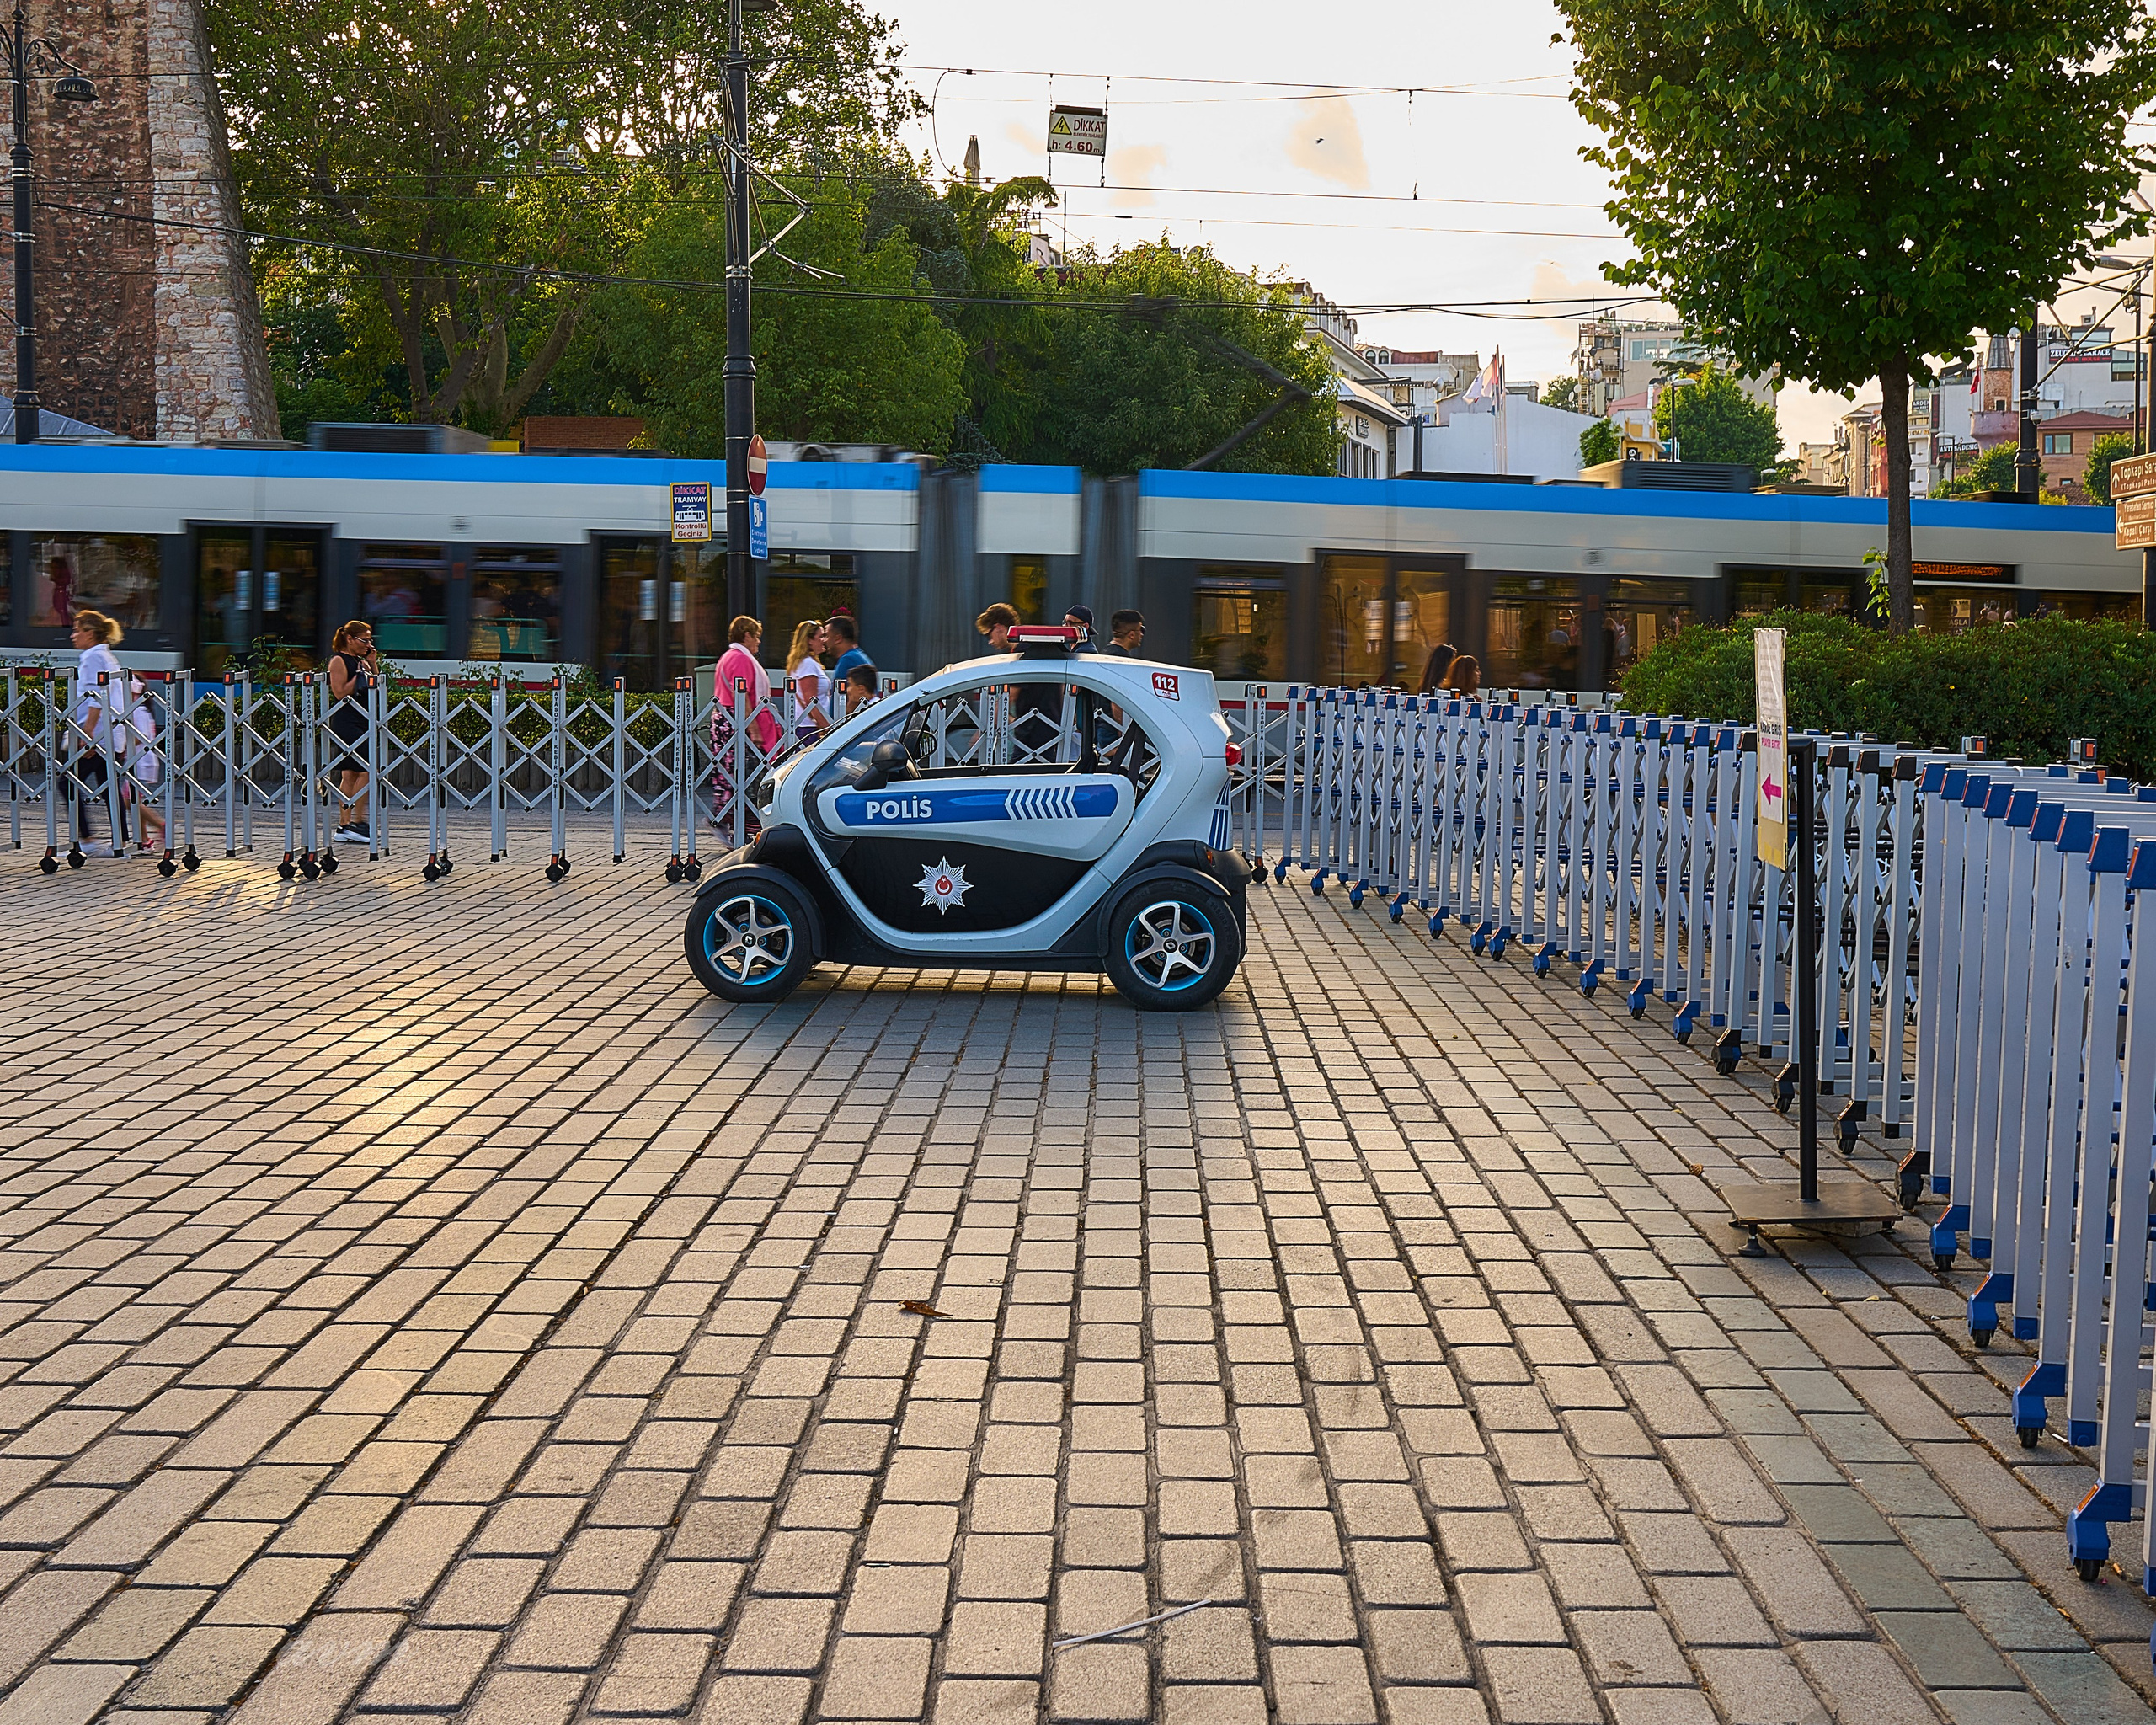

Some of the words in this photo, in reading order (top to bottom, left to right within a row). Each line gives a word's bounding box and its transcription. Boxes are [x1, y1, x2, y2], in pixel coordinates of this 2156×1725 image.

[1073, 118, 1106, 133] DİKKAT
[1051, 139, 1061, 150] h:
[1065, 140, 1093, 152] 4.60
[2120, 463, 2144, 481] Topkapı
[674, 486, 707, 494] DİKKAT
[1155, 676, 1176, 691] 112
[1771, 739, 1781, 750] ENTRY
[867, 794, 933, 820] POLİS
